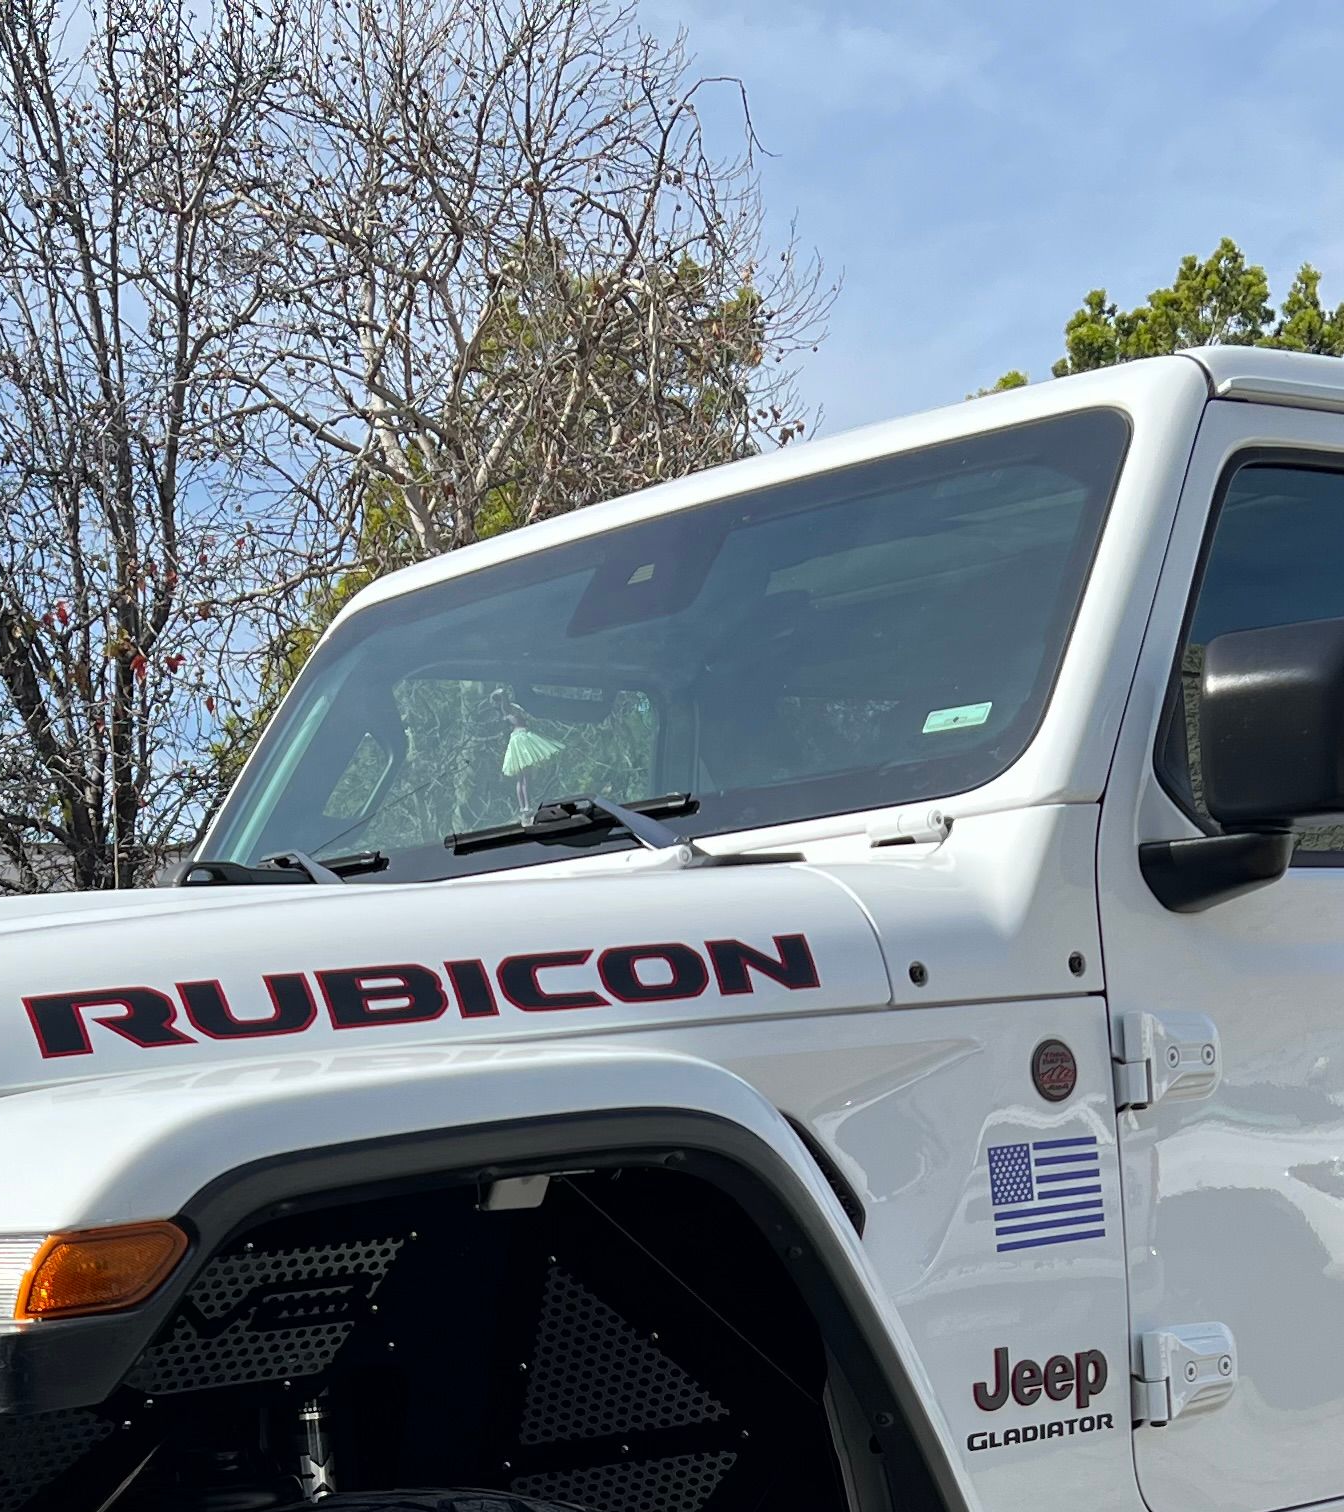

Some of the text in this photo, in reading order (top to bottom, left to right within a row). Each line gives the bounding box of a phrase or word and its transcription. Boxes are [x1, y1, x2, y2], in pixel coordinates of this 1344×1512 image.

[21, 932, 821, 1059] RUBICON
[973, 1346, 1108, 1412] Jeep
[966, 1413, 1115, 1452] GLADIATOR
